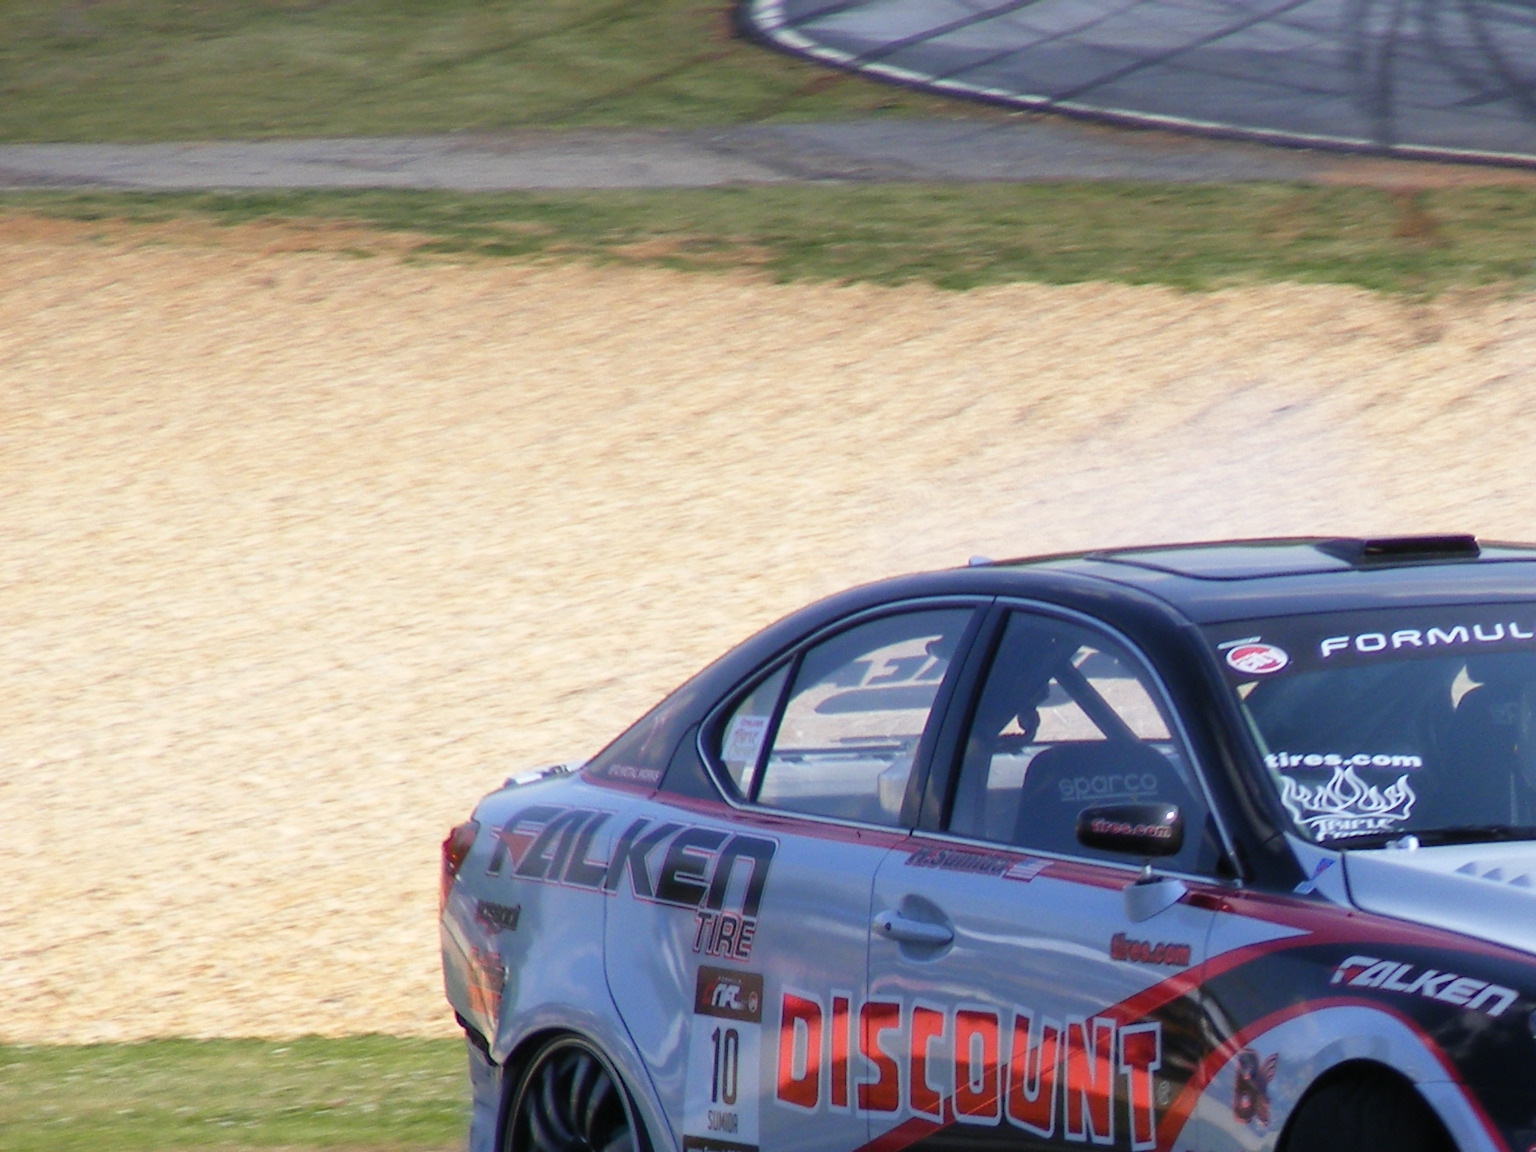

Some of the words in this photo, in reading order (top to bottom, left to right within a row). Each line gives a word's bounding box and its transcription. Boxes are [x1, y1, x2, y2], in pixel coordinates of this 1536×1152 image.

[1058, 773, 1158, 800] sparco
[1264, 752, 1422, 769] tires.com
[486, 804, 781, 918] FALKEN
[692, 909, 757, 963] TIRE
[1329, 954, 1521, 1018] FALKEN
[711, 1025, 740, 1106] 10
[774, 984, 1164, 1152] DISCOUNT
[707, 1109, 740, 1135] SUMIDA
